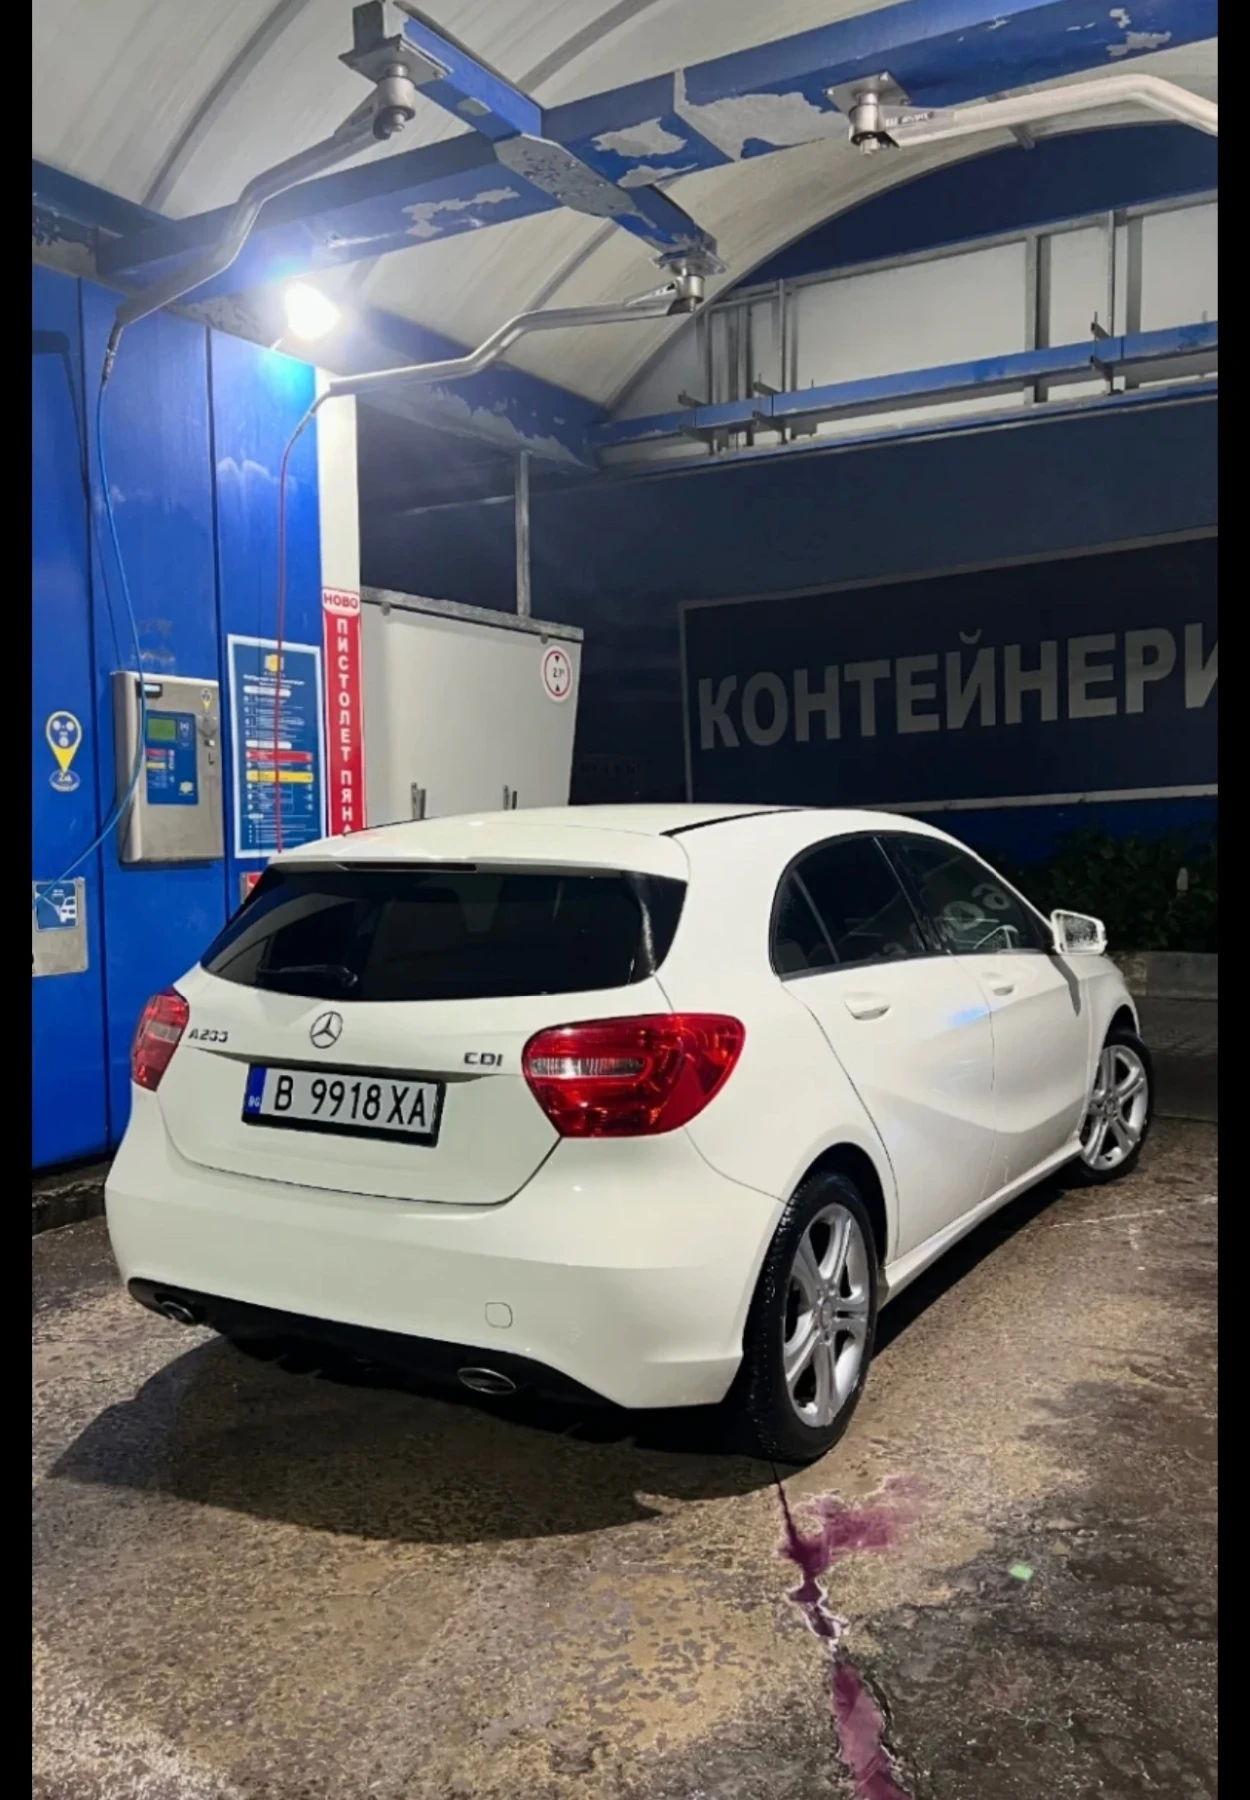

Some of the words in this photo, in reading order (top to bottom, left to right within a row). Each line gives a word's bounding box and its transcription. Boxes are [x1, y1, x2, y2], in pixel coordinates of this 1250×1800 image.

[323, 592, 359, 610] НОВО
[336, 617, 352, 762] ПИСТОЛЕТ
[698, 622, 1218, 750] КОНТЕЙНЕРИ
[463, 1051, 503, 1067] CDI
[273, 1074, 295, 1111] B
